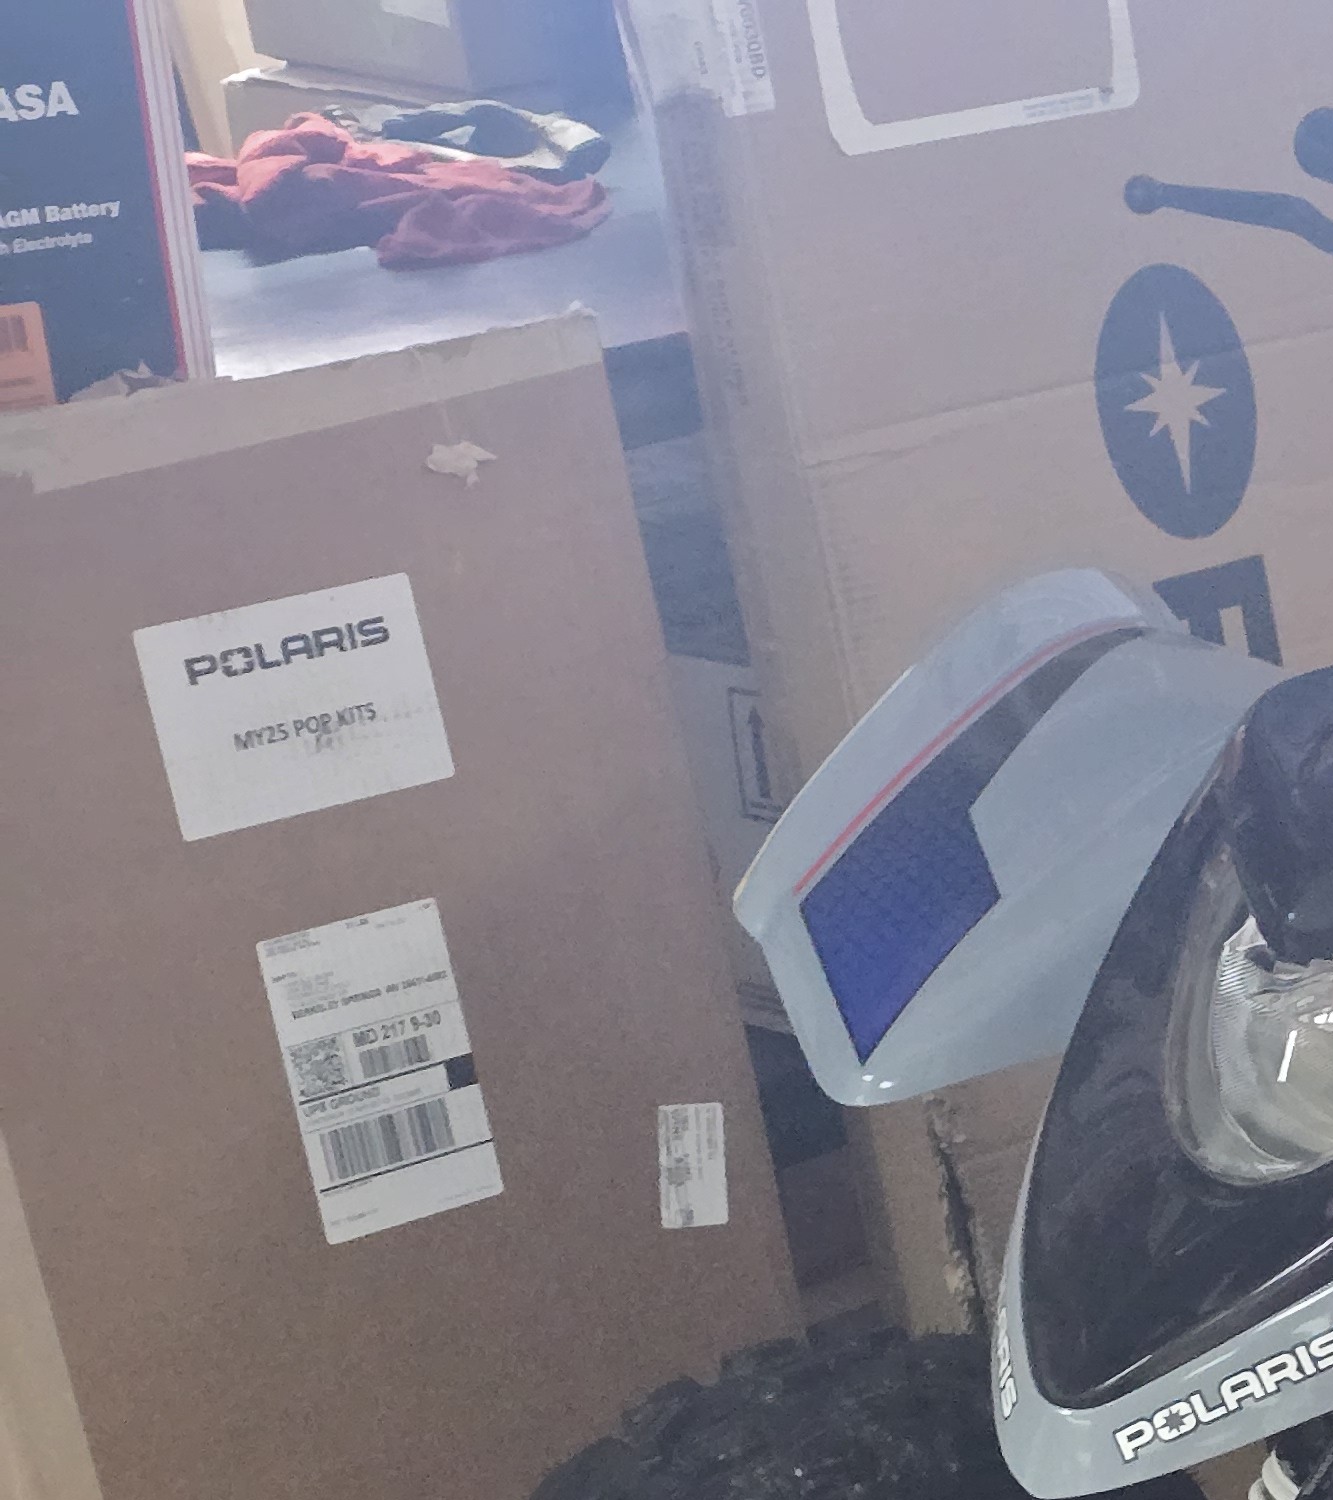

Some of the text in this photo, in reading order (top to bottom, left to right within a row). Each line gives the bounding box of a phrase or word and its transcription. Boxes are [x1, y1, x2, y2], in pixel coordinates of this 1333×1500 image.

[0, 80, 80, 122] ASA
[44, 200, 121, 223] Battery
[183, 615, 390, 686] POLARIS
